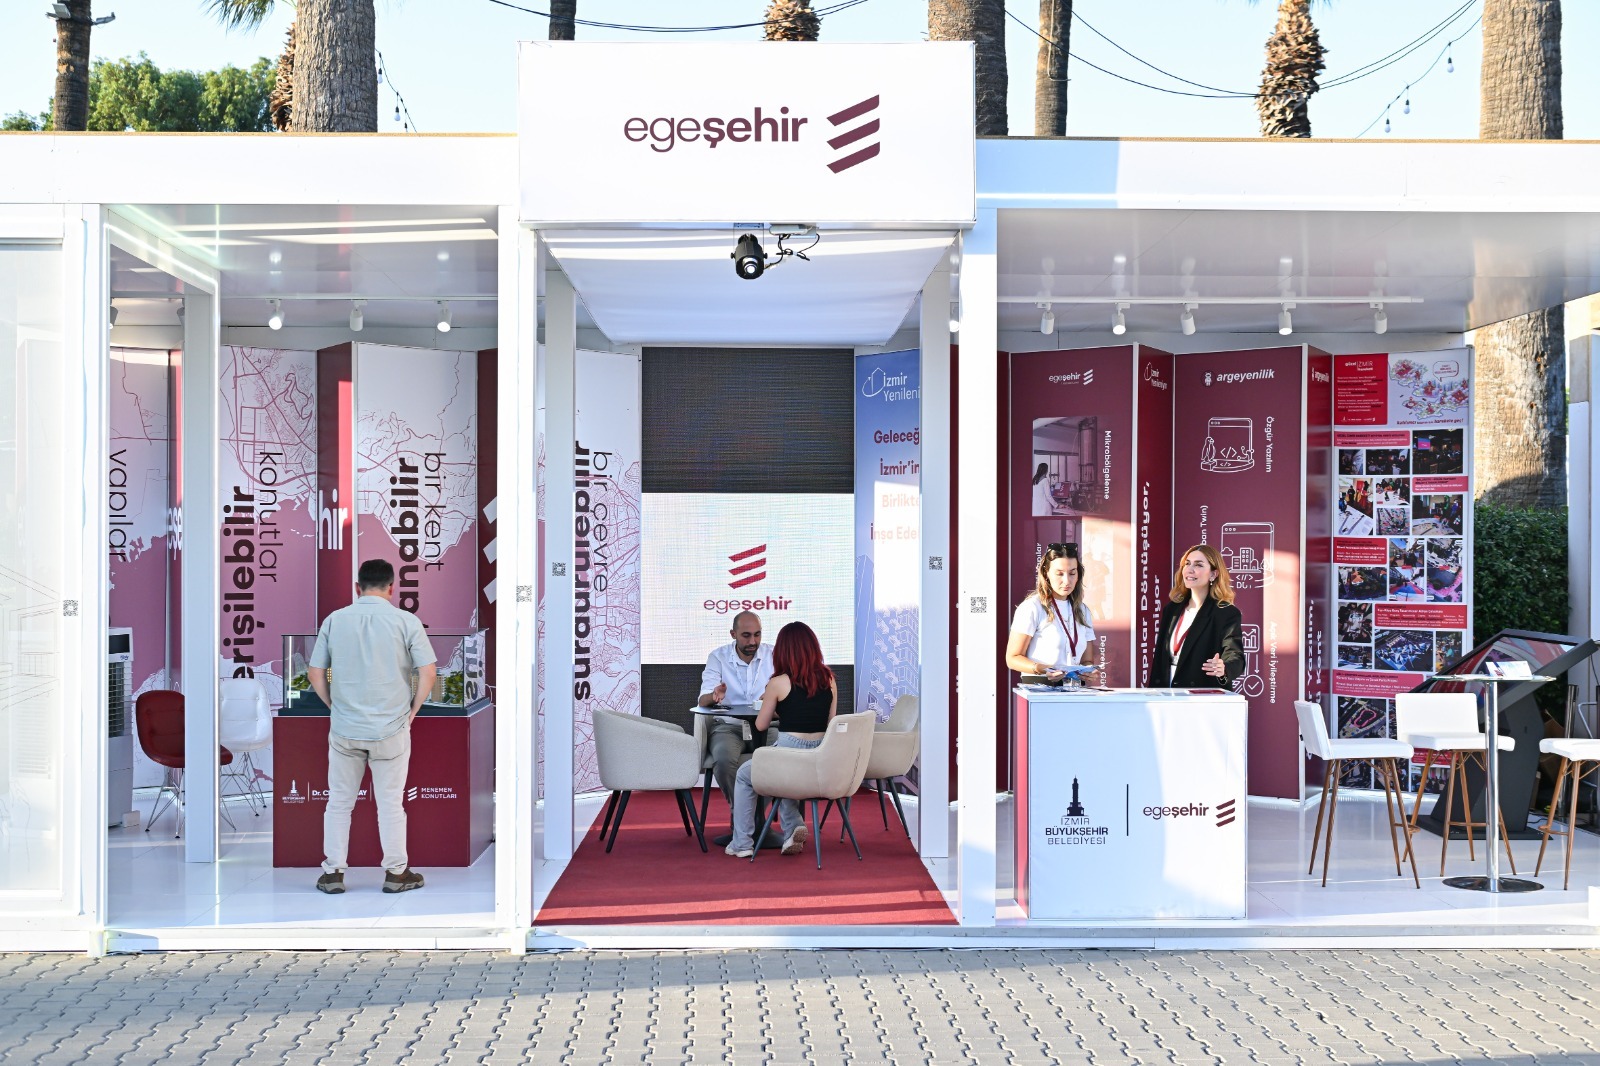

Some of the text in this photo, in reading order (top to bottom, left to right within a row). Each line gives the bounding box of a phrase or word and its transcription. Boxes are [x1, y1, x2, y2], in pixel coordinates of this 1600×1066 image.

[624, 106, 808, 153] egeşehir
[883, 372, 908, 387] İzmir
[1048, 371, 1081, 384] egeşehir
[1216, 368, 1275, 384] argeyenilik
[1103, 430, 1112, 500] Mikrobölgeleme
[1264, 415, 1275, 473] Özgür Yazılım
[259, 451, 284, 583] konutlar
[424, 452, 447, 572] bir kent
[590, 451, 612, 593] bir çevre
[1200, 505, 1209, 528] Twin)
[390, 457, 420, 615] anabilir
[1140, 481, 1150, 611] Dönüşüyor,
[1140, 617, 1149, 688] apılar
[1045, 825, 1109, 838] BÜYÜKŞEHİR
[1060, 816, 1090, 826] İZMİR
[1142, 802, 1210, 820] egeşehir
[1047, 836, 1106, 845] BELEDİYESİ
